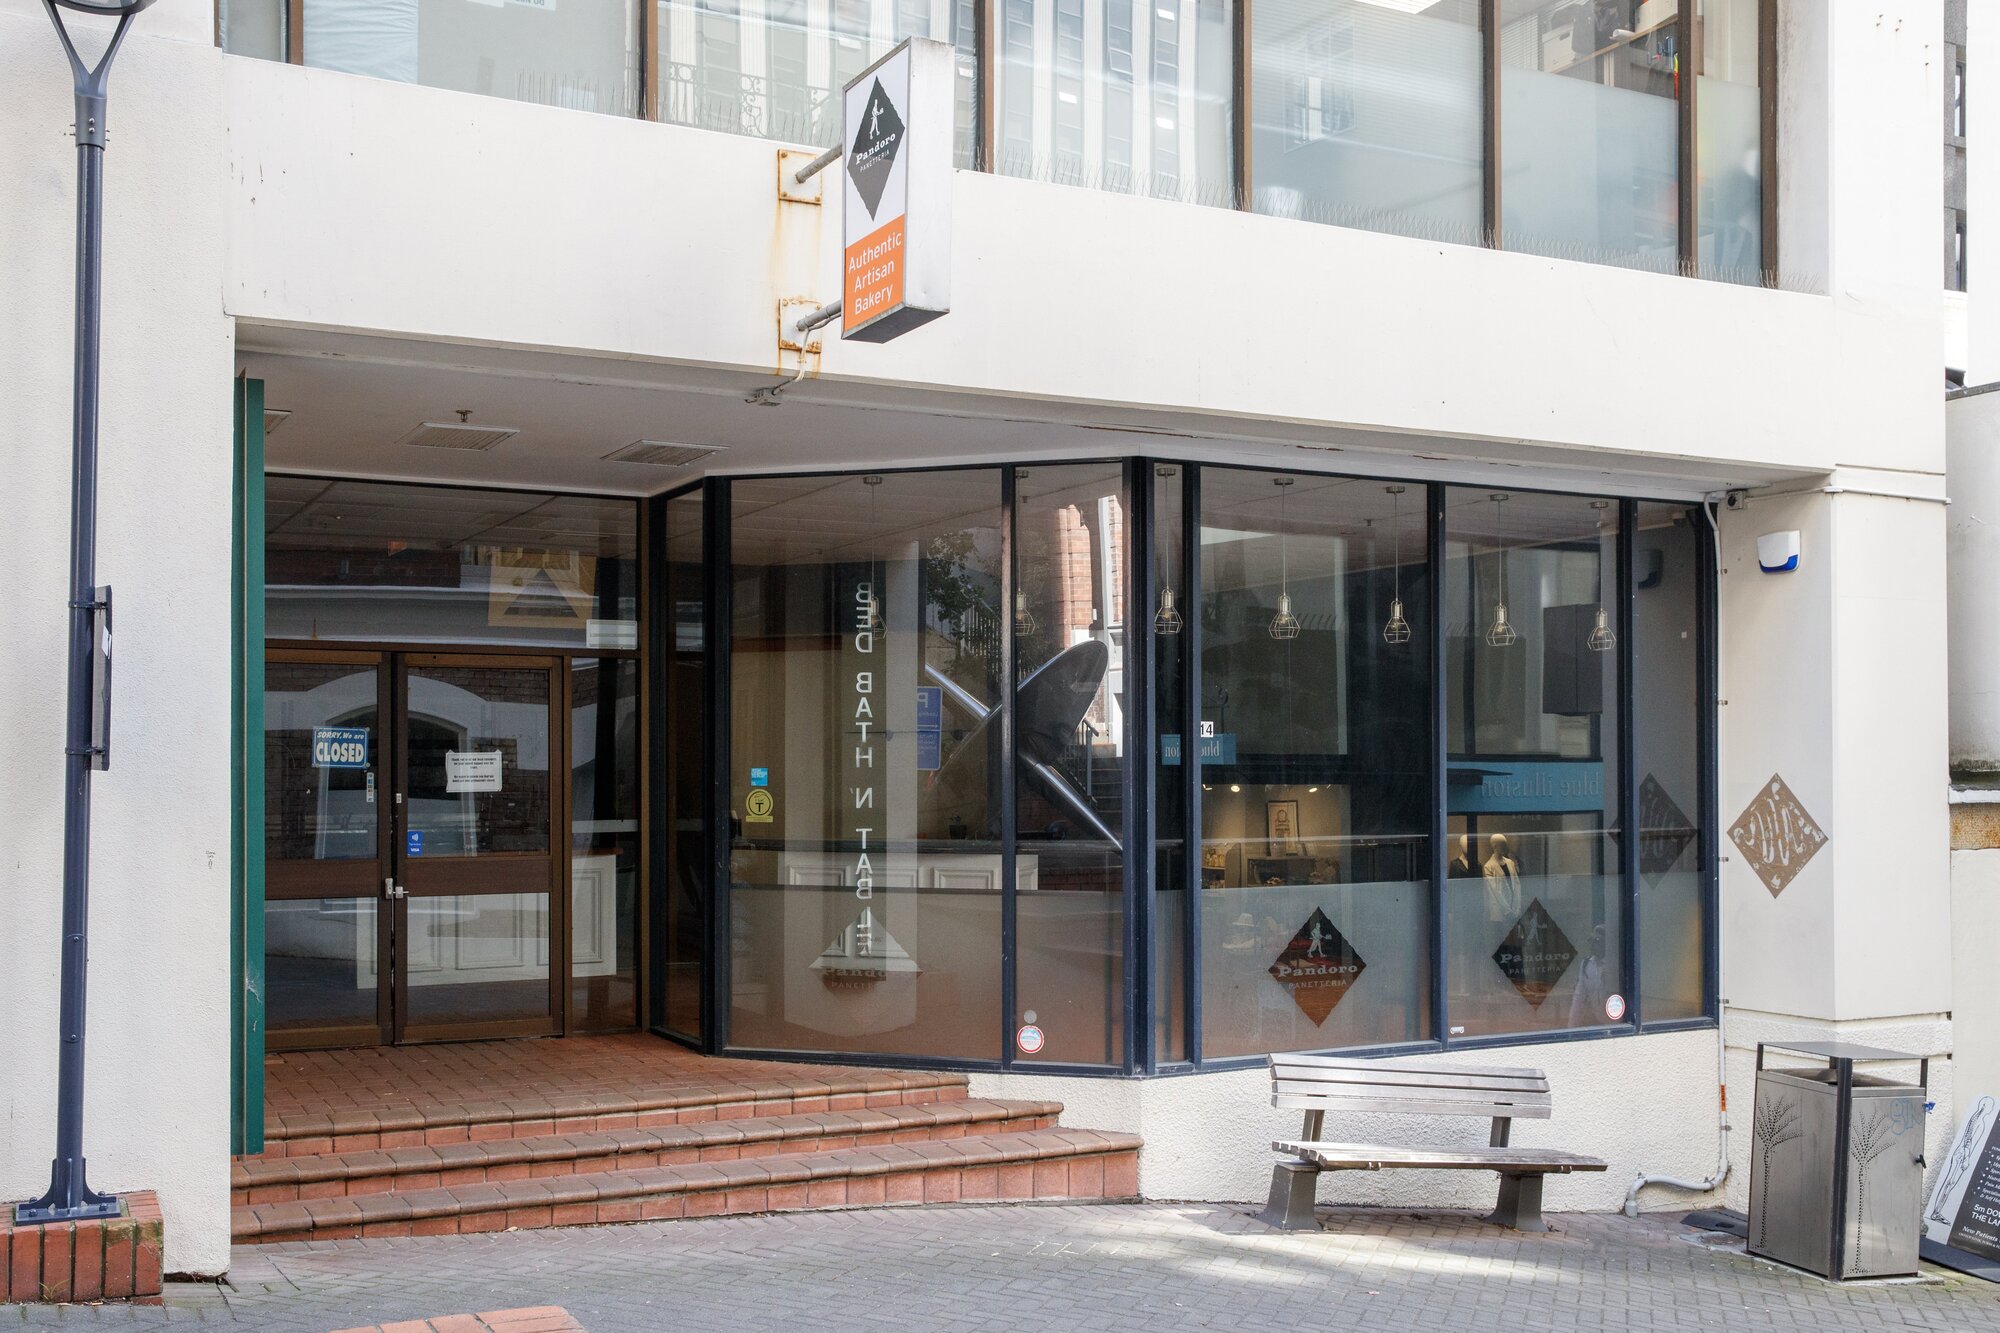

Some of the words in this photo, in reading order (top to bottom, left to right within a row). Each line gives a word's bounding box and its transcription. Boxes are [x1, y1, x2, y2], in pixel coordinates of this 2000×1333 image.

[856, 133, 895, 165] Pandoro
[860, 149, 889, 173] PANETTERIA
[848, 231, 902, 274] Authentic
[854, 260, 894, 293] Artisan
[855, 284, 893, 315] Bakery
[317, 731, 342, 740] SORRY,
[342, 732, 353, 740] We
[316, 742, 365, 762] CLOSED
[1500, 951, 1570, 964] Pandoro
[1277, 964, 1358, 978] Pandoro
[1289, 979, 1347, 990] PANETTERIA
[1973, 1204, 1985, 1213] 5m
[1971, 1212, 1987, 1223] THE
[1961, 1226, 1976, 1234] New
[1976, 1231, 1999, 1242] Patients
